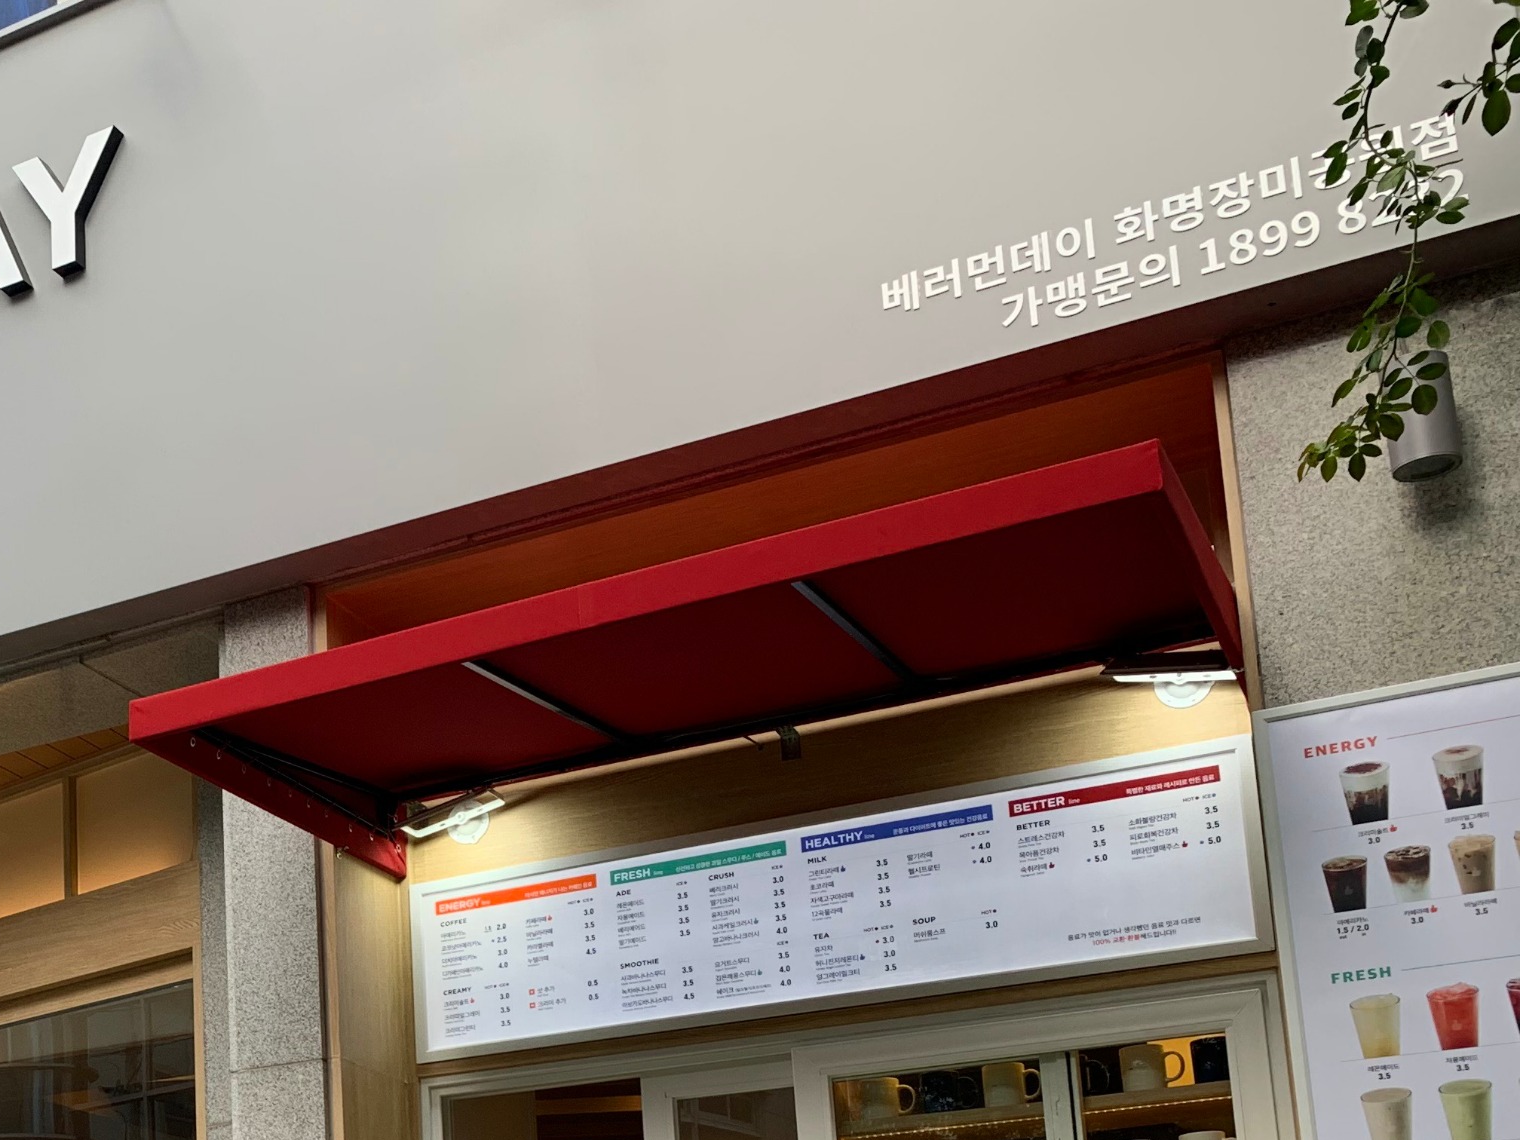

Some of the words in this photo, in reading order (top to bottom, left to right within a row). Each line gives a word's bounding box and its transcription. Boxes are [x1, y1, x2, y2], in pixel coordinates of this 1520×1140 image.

[880, 218, 1097, 313] 베러먼데이
[1000, 246, 1181, 328] 가맹문의
[1199, 210, 1321, 277] 1899
[1304, 736, 1378, 758] ENERGY
[1013, 796, 1065, 813] BETTER
[1204, 806, 1218, 814] 3.5
[1016, 820, 1050, 830] BETTER
[1206, 821, 1220, 829] 3.5
[1018, 831, 1064, 844] 스트레스건강차
[1092, 825, 1104, 833] 3.5
[805, 831, 863, 849] HEALTHY
[1093, 839, 1106, 847] 3.5
[1208, 836, 1221, 844] 5.0
[1368, 836, 1381, 844] 3.0
[978, 842, 991, 850] 4.0
[807, 856, 827, 864] MILK
[979, 855, 992, 864] 4.0
[1094, 854, 1107, 862] 5.0
[876, 858, 889, 867] 3.5
[614, 868, 651, 883] FRESH
[708, 872, 735, 881] CRUSH
[772, 875, 784, 884] 3.0
[877, 872, 890, 881] 3.5
[616, 889, 631, 897] ADE
[773, 888, 785, 896] 3.5
[878, 886, 891, 894] 3.5
[677, 891, 688, 900] 3.5
[438, 897, 481, 913] ENERGY
[774, 901, 786, 909] 3.5
[879, 899, 892, 908] 3.5
[583, 908, 595, 916] 3.0
[678, 904, 689, 912] 3.5
[678, 917, 690, 925] 3.5
[775, 914, 787, 922] 3.5
[913, 917, 936, 925] SOUP
[1411, 916, 1424, 924] 3.0
[440, 918, 467, 927] COFFEE
[584, 921, 595, 929] 3.5
[985, 920, 998, 929] 3.0
[497, 923, 507, 931] 2.0
[776, 926, 788, 935] 4.0
[679, 929, 691, 937] 3.5
[585, 934, 596, 942] 3.5
[882, 936, 895, 944] 3.0
[883, 950, 896, 958] 3.0
[620, 958, 659, 970] SMOOTHIE
[885, 964, 897, 972] 3.5
[682, 966, 693, 974] 3.5
[779, 965, 791, 973] 4.0
[1331, 966, 1392, 984] FRESH
[587, 979, 599, 987] 0.5
[683, 979, 694, 987] 3.5
[443, 986, 472, 996] CREAMY
[500, 992, 510, 1000] 3.0
[588, 993, 599, 1001] 0.5
[500, 1006, 511, 1014] 3.5
[501, 1019, 512, 1027] 3.5
[1456, 1063, 1470, 1072] 3.5
[1378, 1072, 1391, 1080] 3.5
